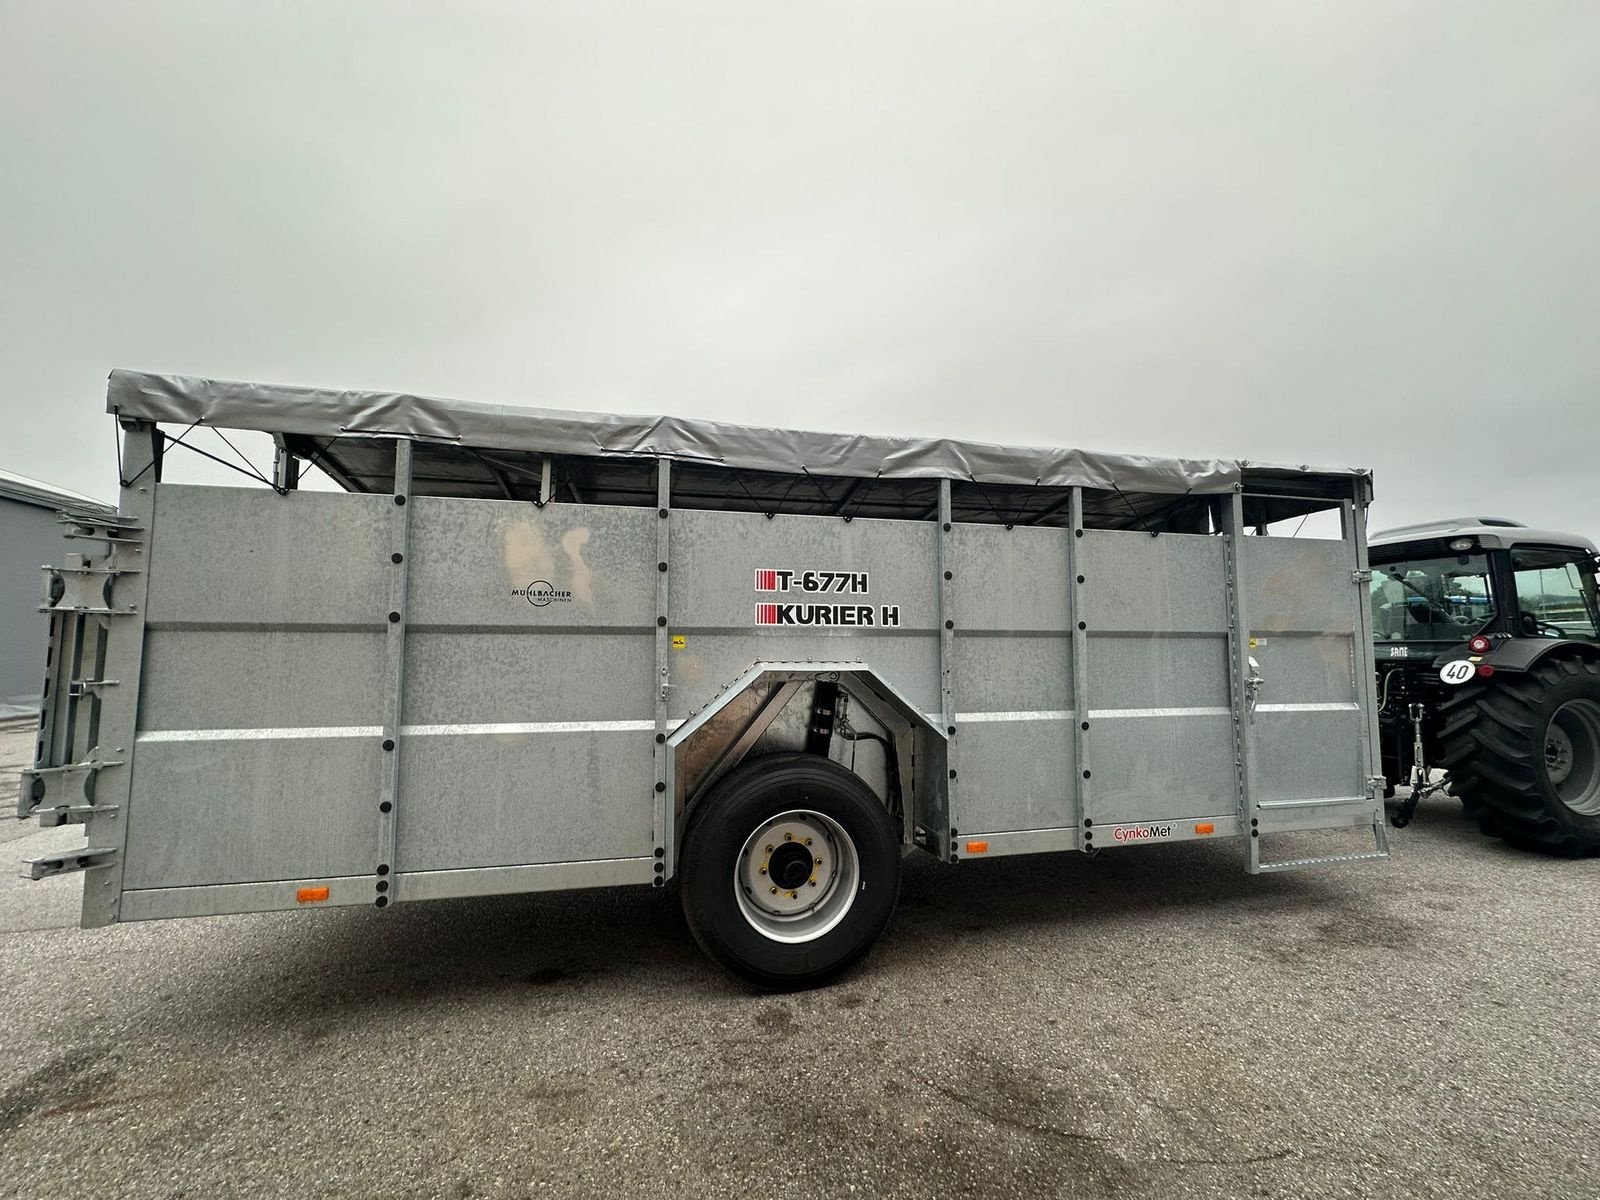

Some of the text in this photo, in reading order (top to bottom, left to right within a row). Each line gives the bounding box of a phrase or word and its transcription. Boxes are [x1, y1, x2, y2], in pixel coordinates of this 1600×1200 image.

[776, 570, 868, 593] T-677H
[776, 604, 899, 626] KURIER H
[1390, 646, 1408, 657] SAME
[1446, 664, 1469, 680] 40
